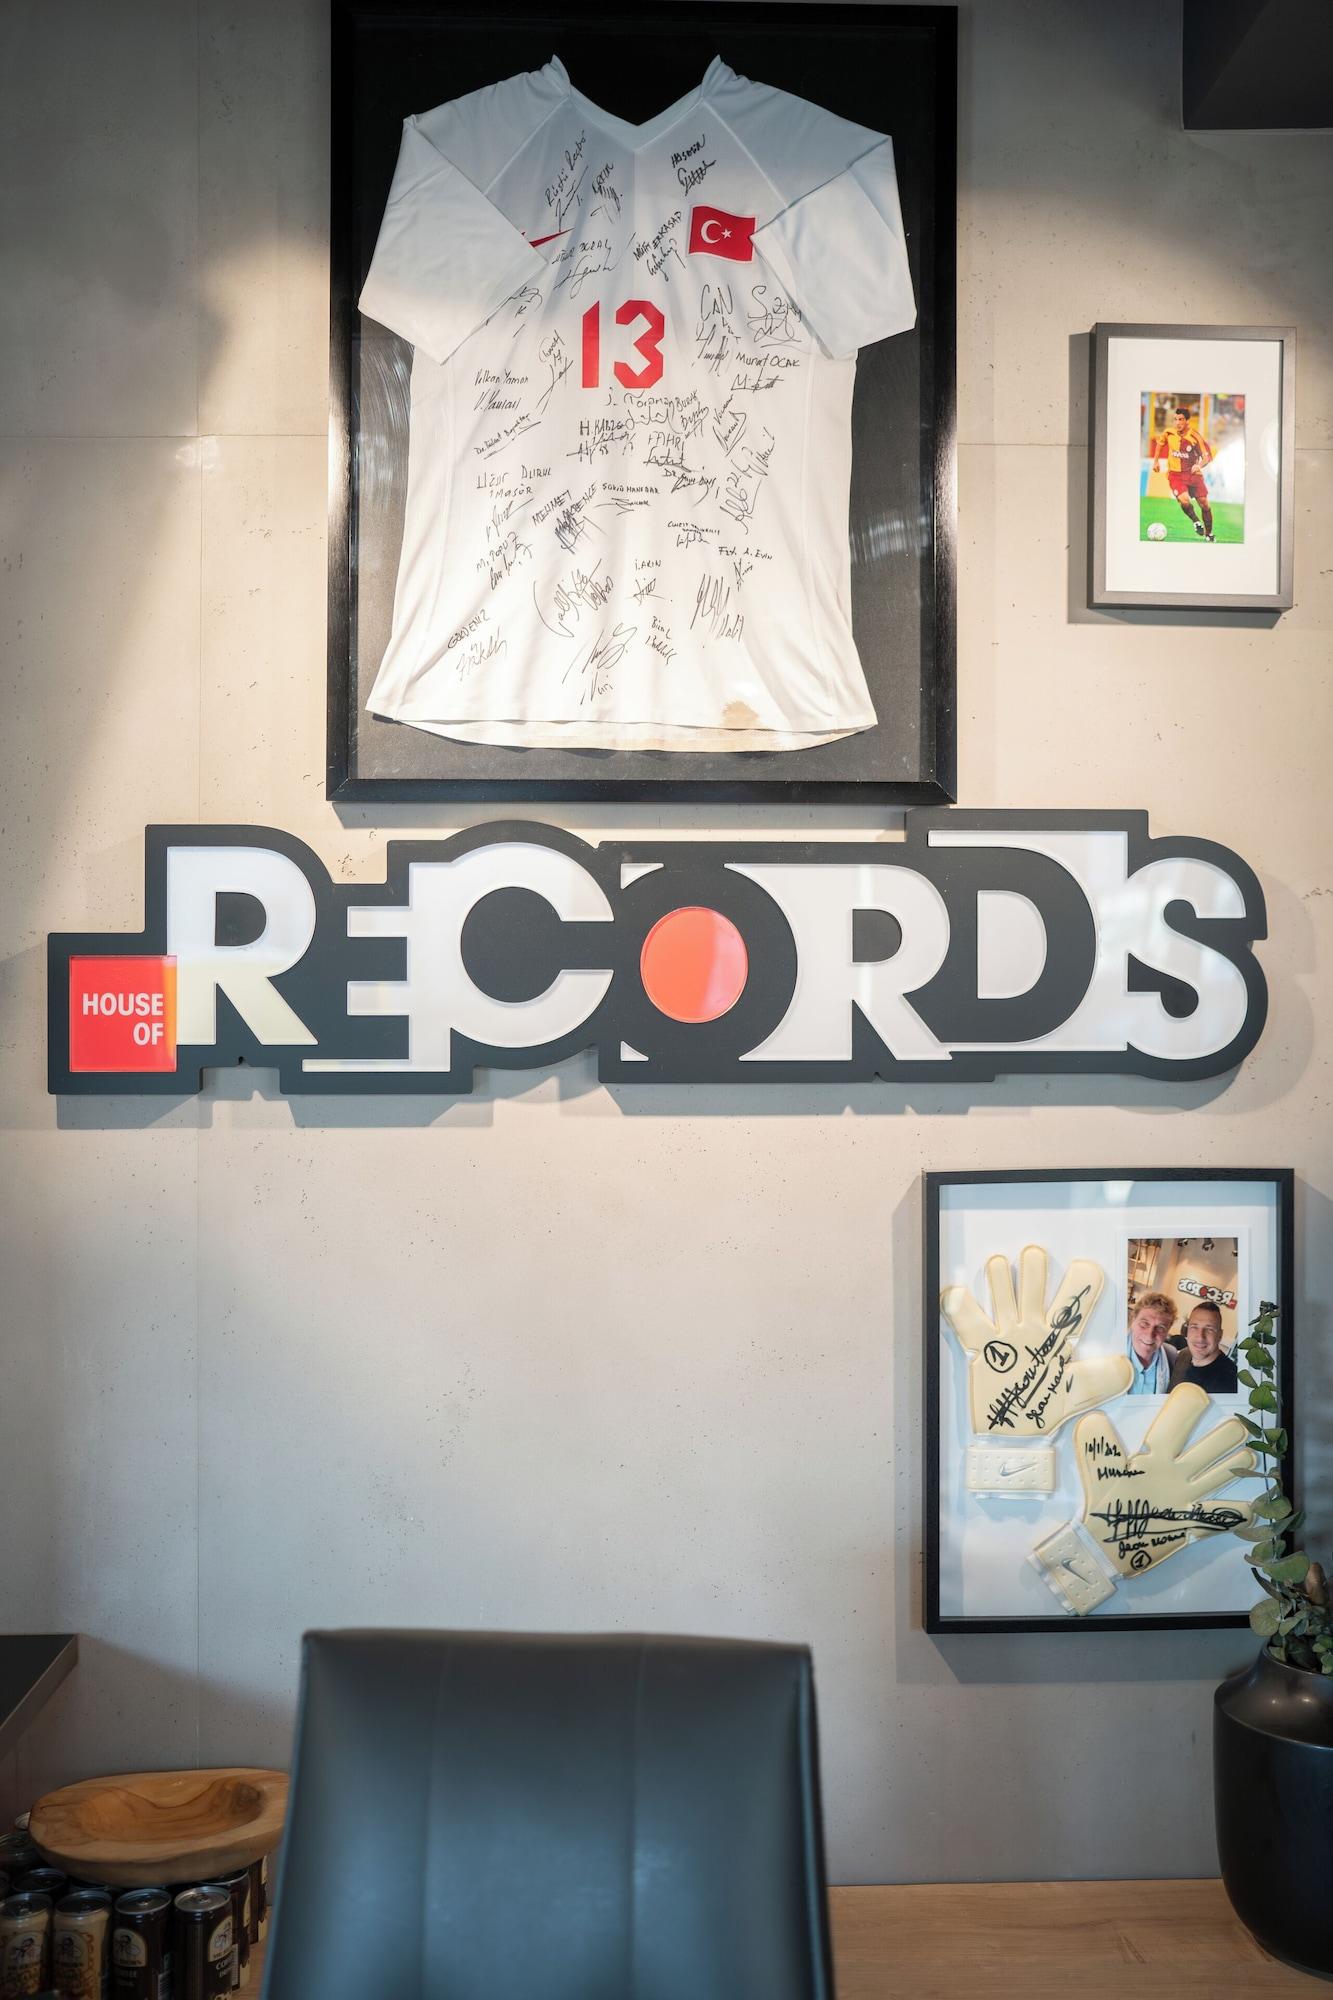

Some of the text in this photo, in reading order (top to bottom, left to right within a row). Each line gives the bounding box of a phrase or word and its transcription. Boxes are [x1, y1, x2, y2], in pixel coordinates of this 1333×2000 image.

[582, 299, 665, 389] 13
[166, 830, 1250, 1074] RECORDS
[82, 992, 164, 1016] HOUSE
[133, 1022, 164, 1046] OF
